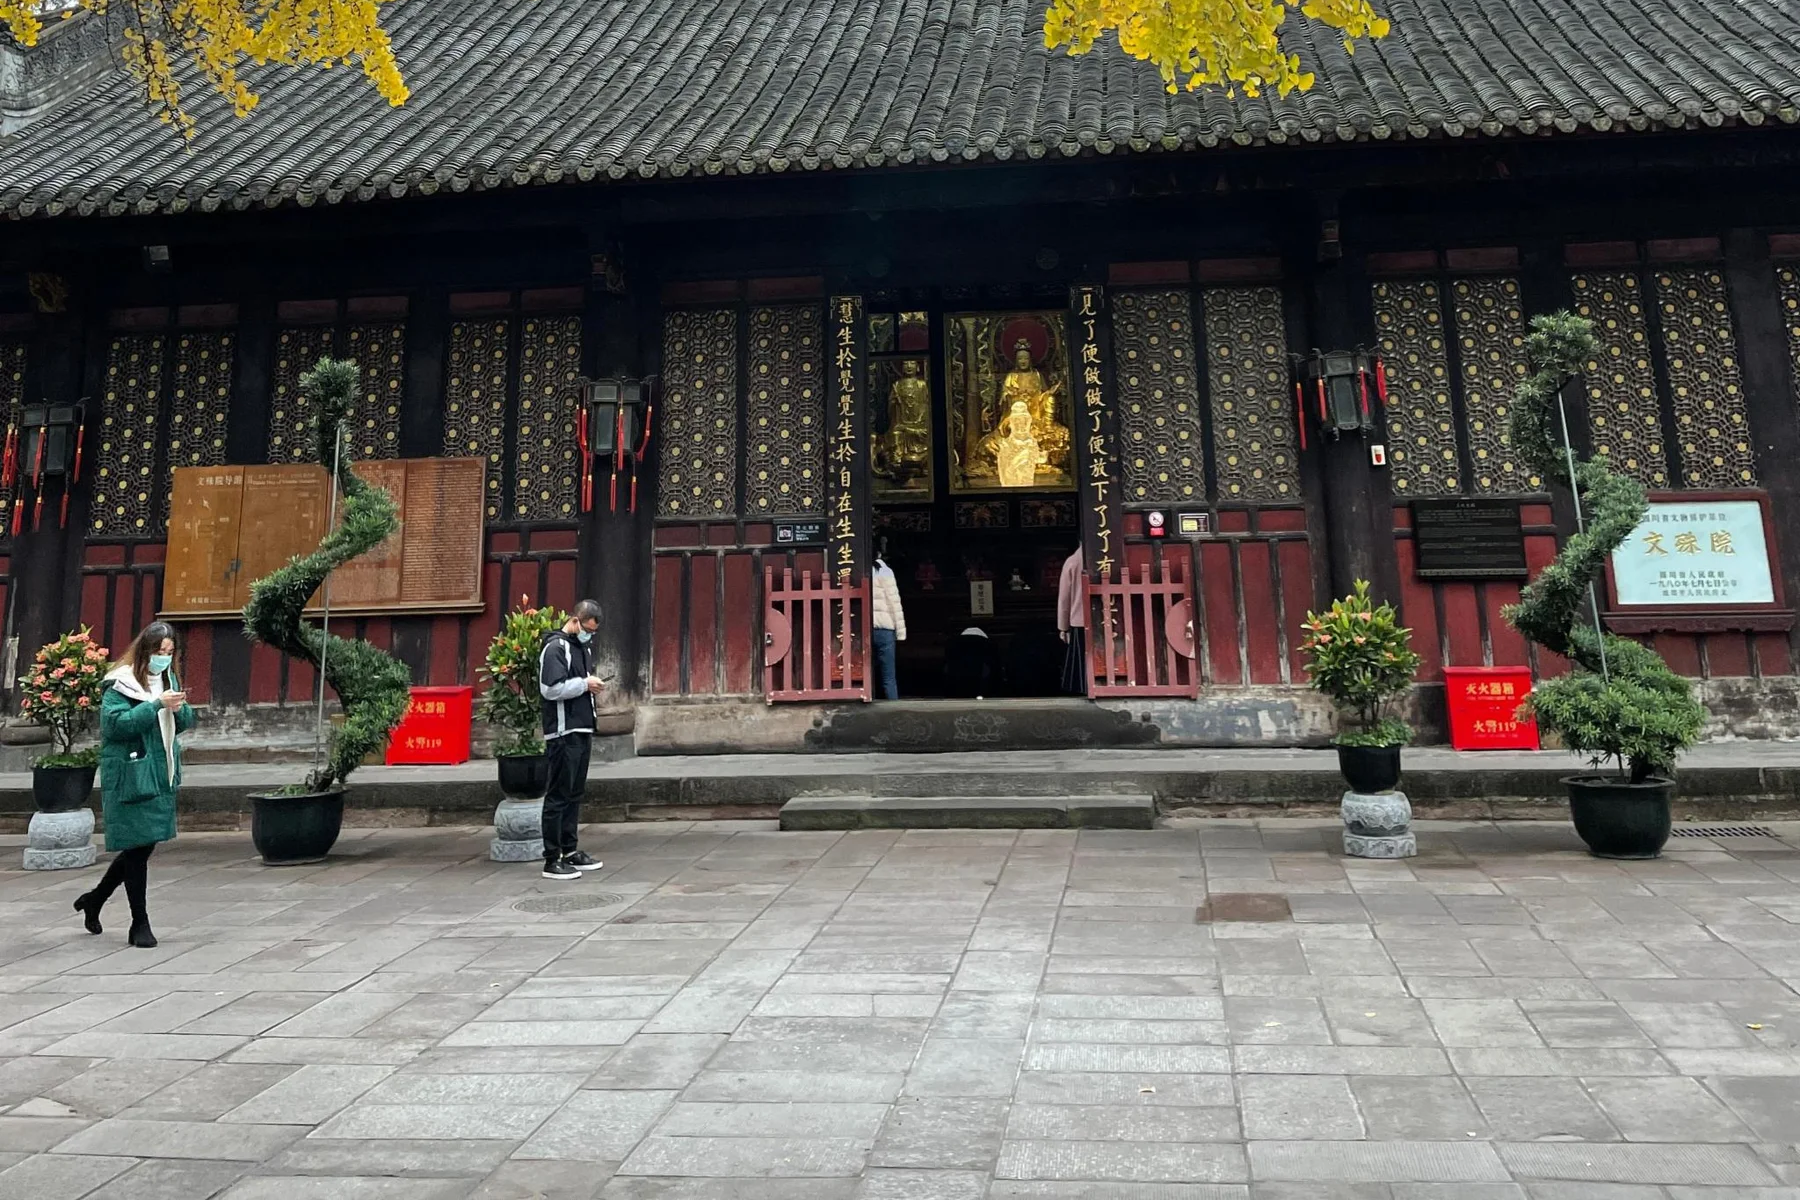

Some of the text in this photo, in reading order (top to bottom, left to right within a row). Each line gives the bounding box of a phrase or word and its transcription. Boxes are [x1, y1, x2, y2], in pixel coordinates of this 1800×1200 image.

[1643, 530, 1736, 556] 文殊院
[1465, 682, 1514, 695] 灭火器箱
[1473, 719, 1517, 733] 火警119
